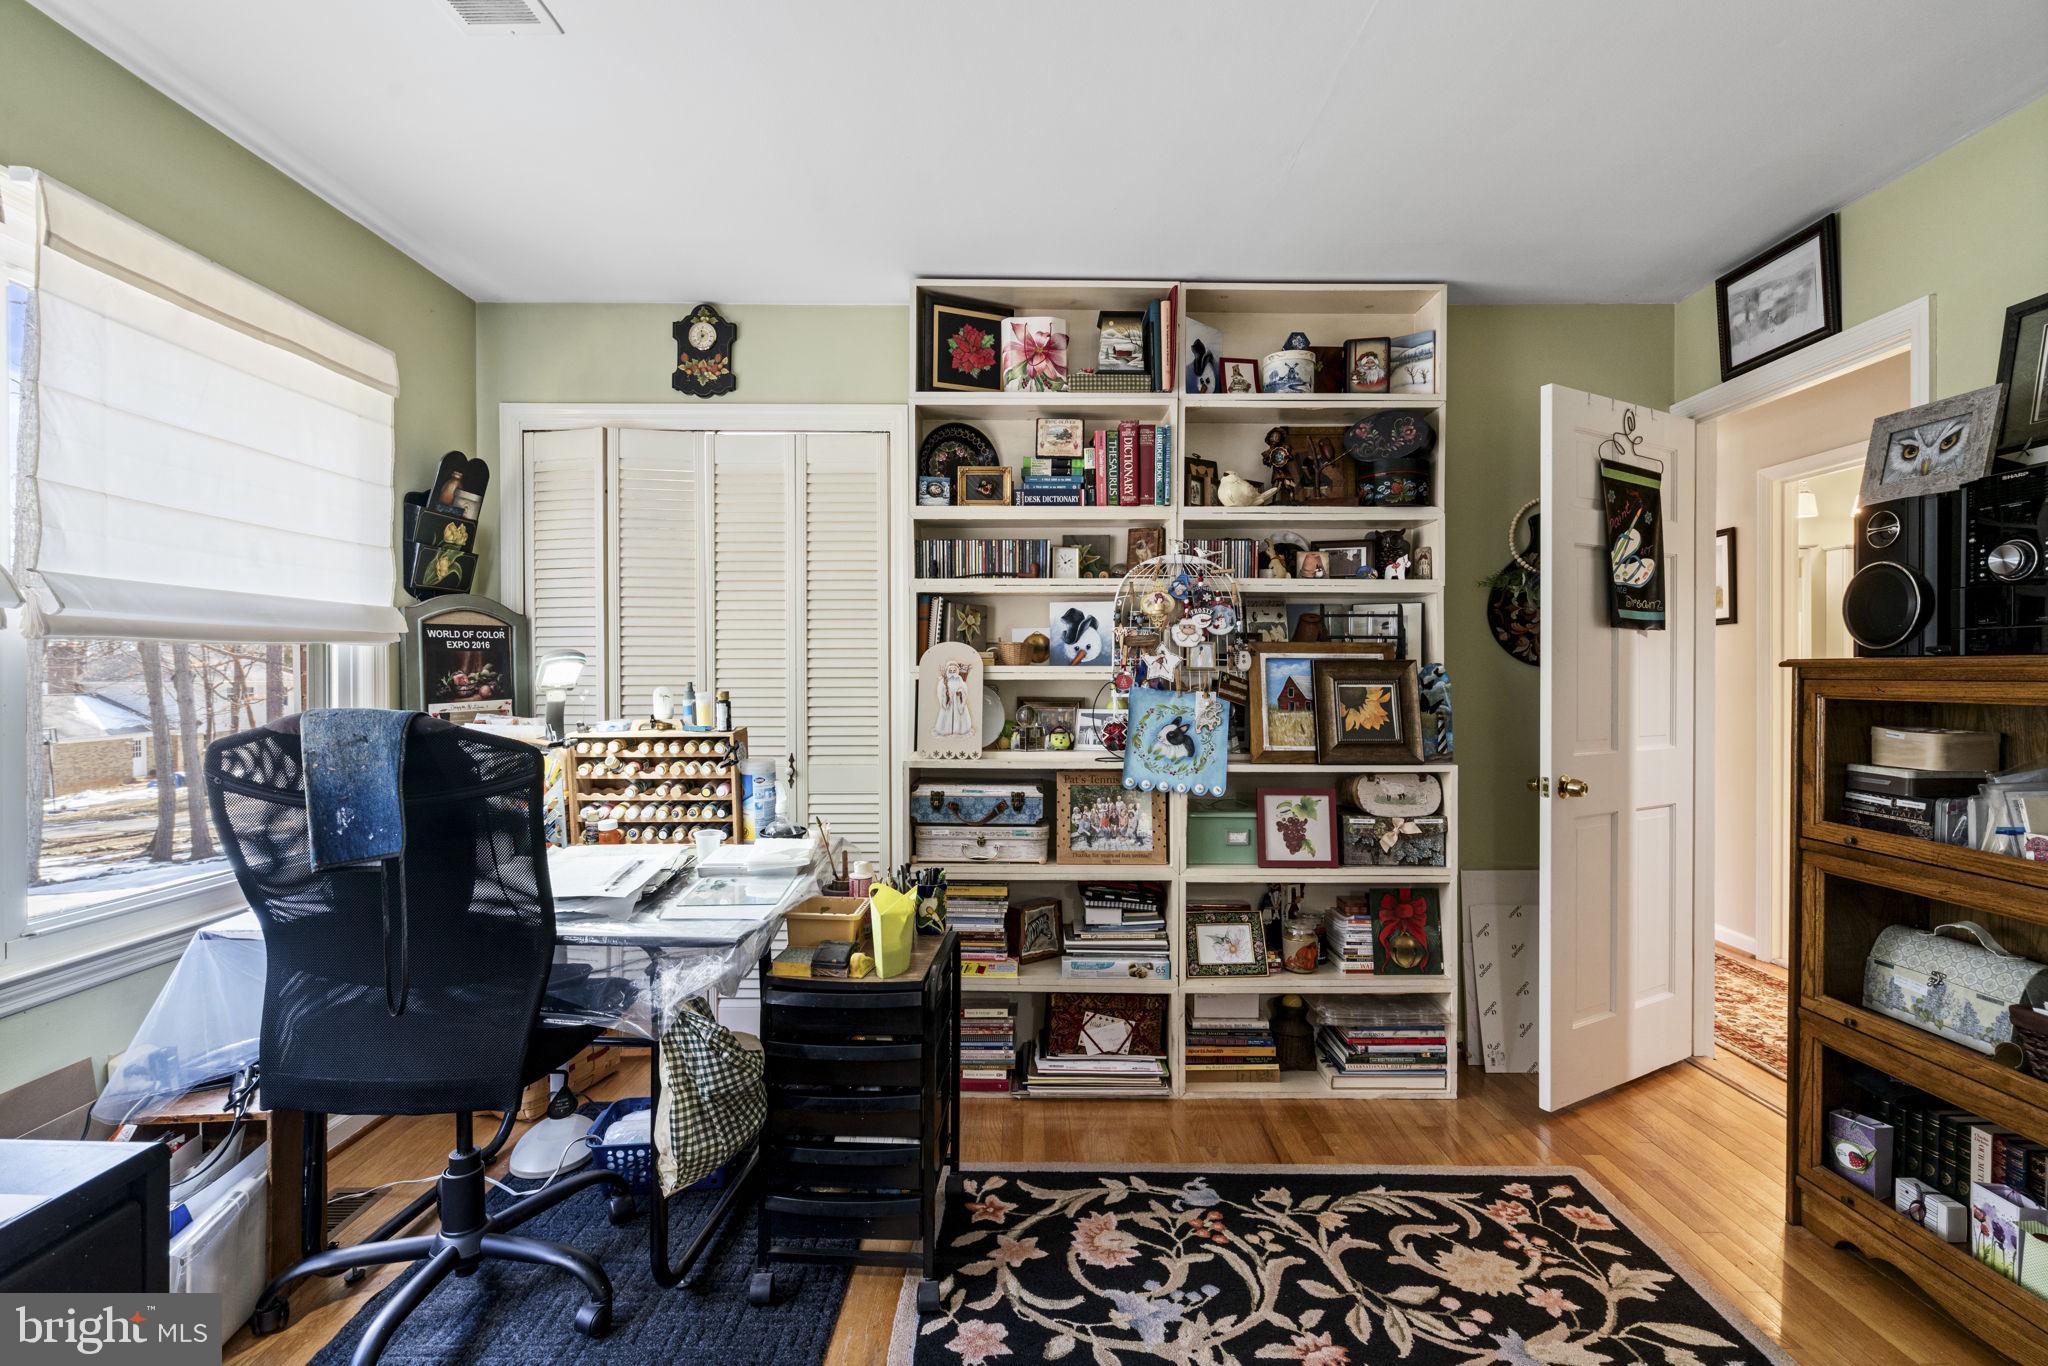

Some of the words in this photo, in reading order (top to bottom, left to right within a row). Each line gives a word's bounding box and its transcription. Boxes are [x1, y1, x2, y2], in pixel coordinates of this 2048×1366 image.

[1108, 440, 1118, 496] THESAURUS
[1123, 437, 1134, 496] DICTIONARY
[1156, 462, 1164, 482] BOOK
[2002, 471, 2029, 480] SHARP
[1024, 495, 1041, 503] DESK
[1042, 495, 1080, 503] DICTIONARY
[1190, 607, 1214, 615] FROSTY
[426, 629, 461, 639] WORLD
[462, 630, 475, 639] OF
[476, 630, 506, 639] COLOR
[446, 640, 470, 649] EXPO
[471, 641, 491, 649] 2016
[1063, 775, 1087, 784] Pat's
[1088, 775, 1120, 784] Tennis
[1155, 965, 1166, 974] 65
